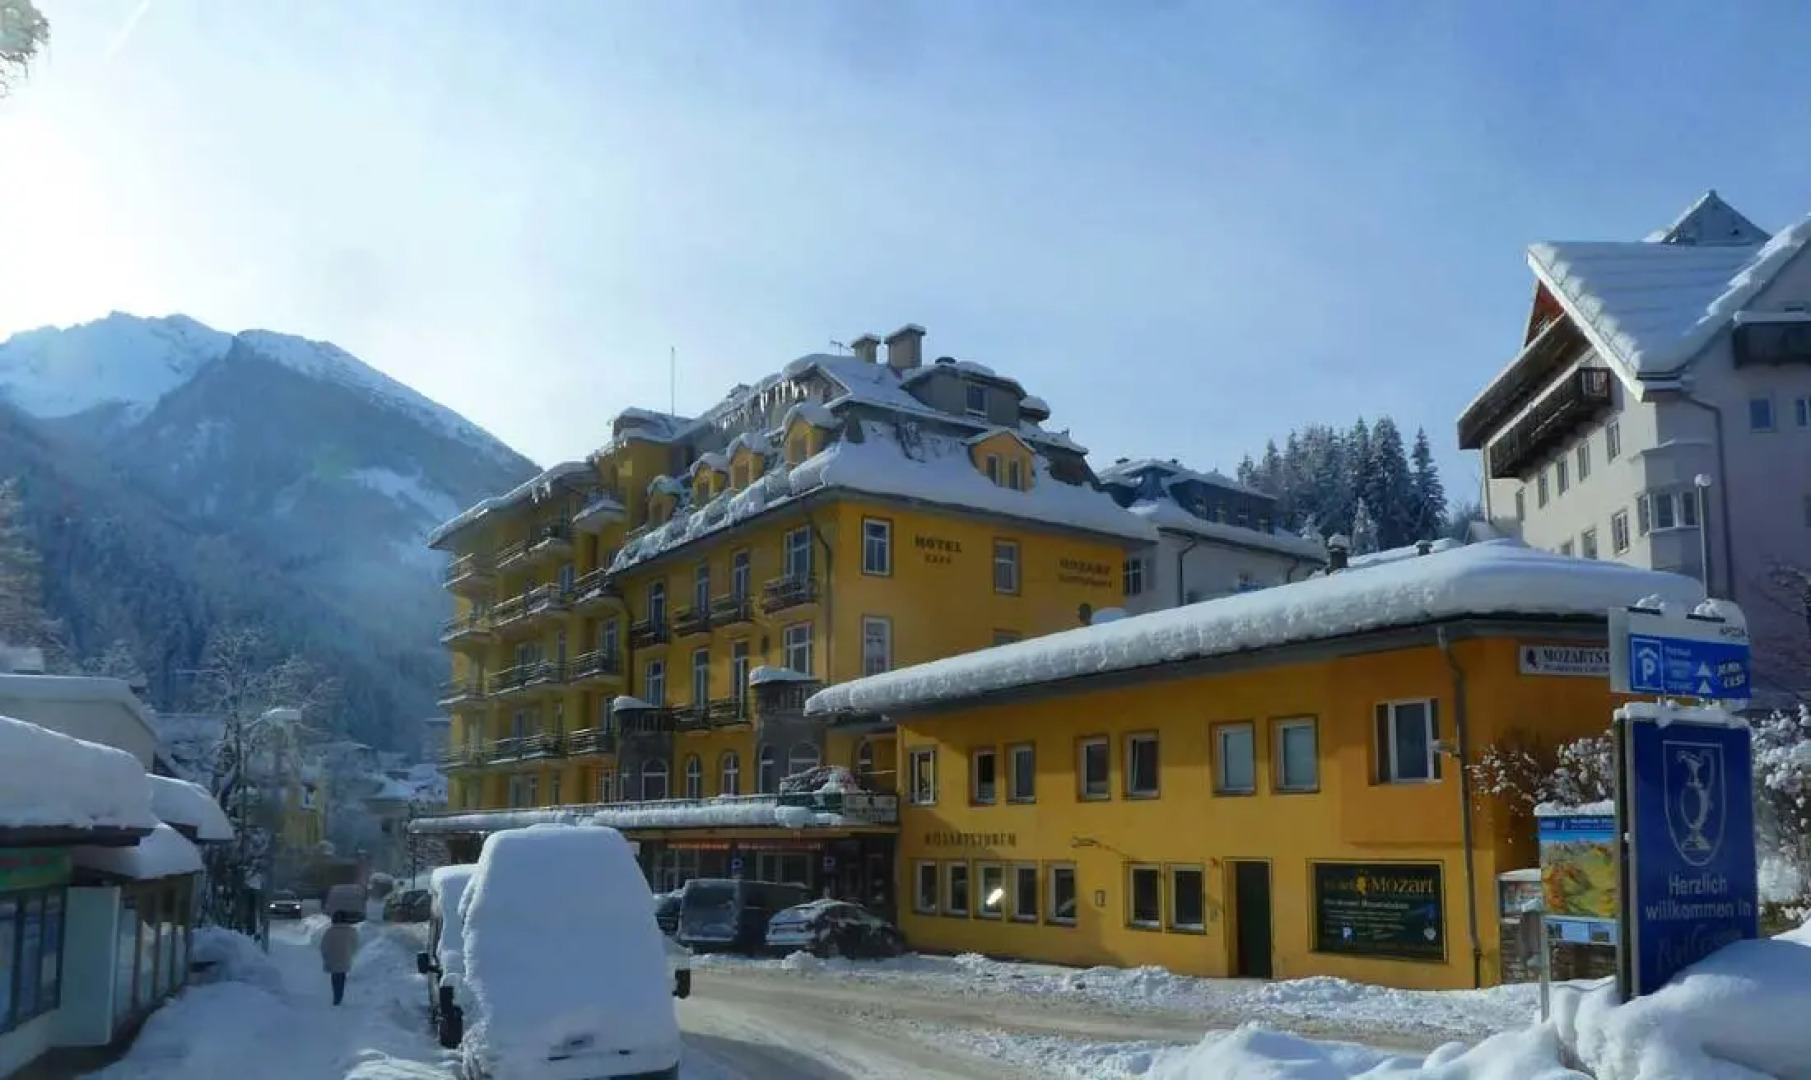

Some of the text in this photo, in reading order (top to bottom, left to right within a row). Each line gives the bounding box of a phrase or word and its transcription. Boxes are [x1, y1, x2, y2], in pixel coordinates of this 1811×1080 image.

[915, 534, 962, 553] HOTEL
[1643, 658, 1655, 681] P
[1668, 873, 1728, 895] Herzlich
[1646, 899, 1735, 919] willkommen
